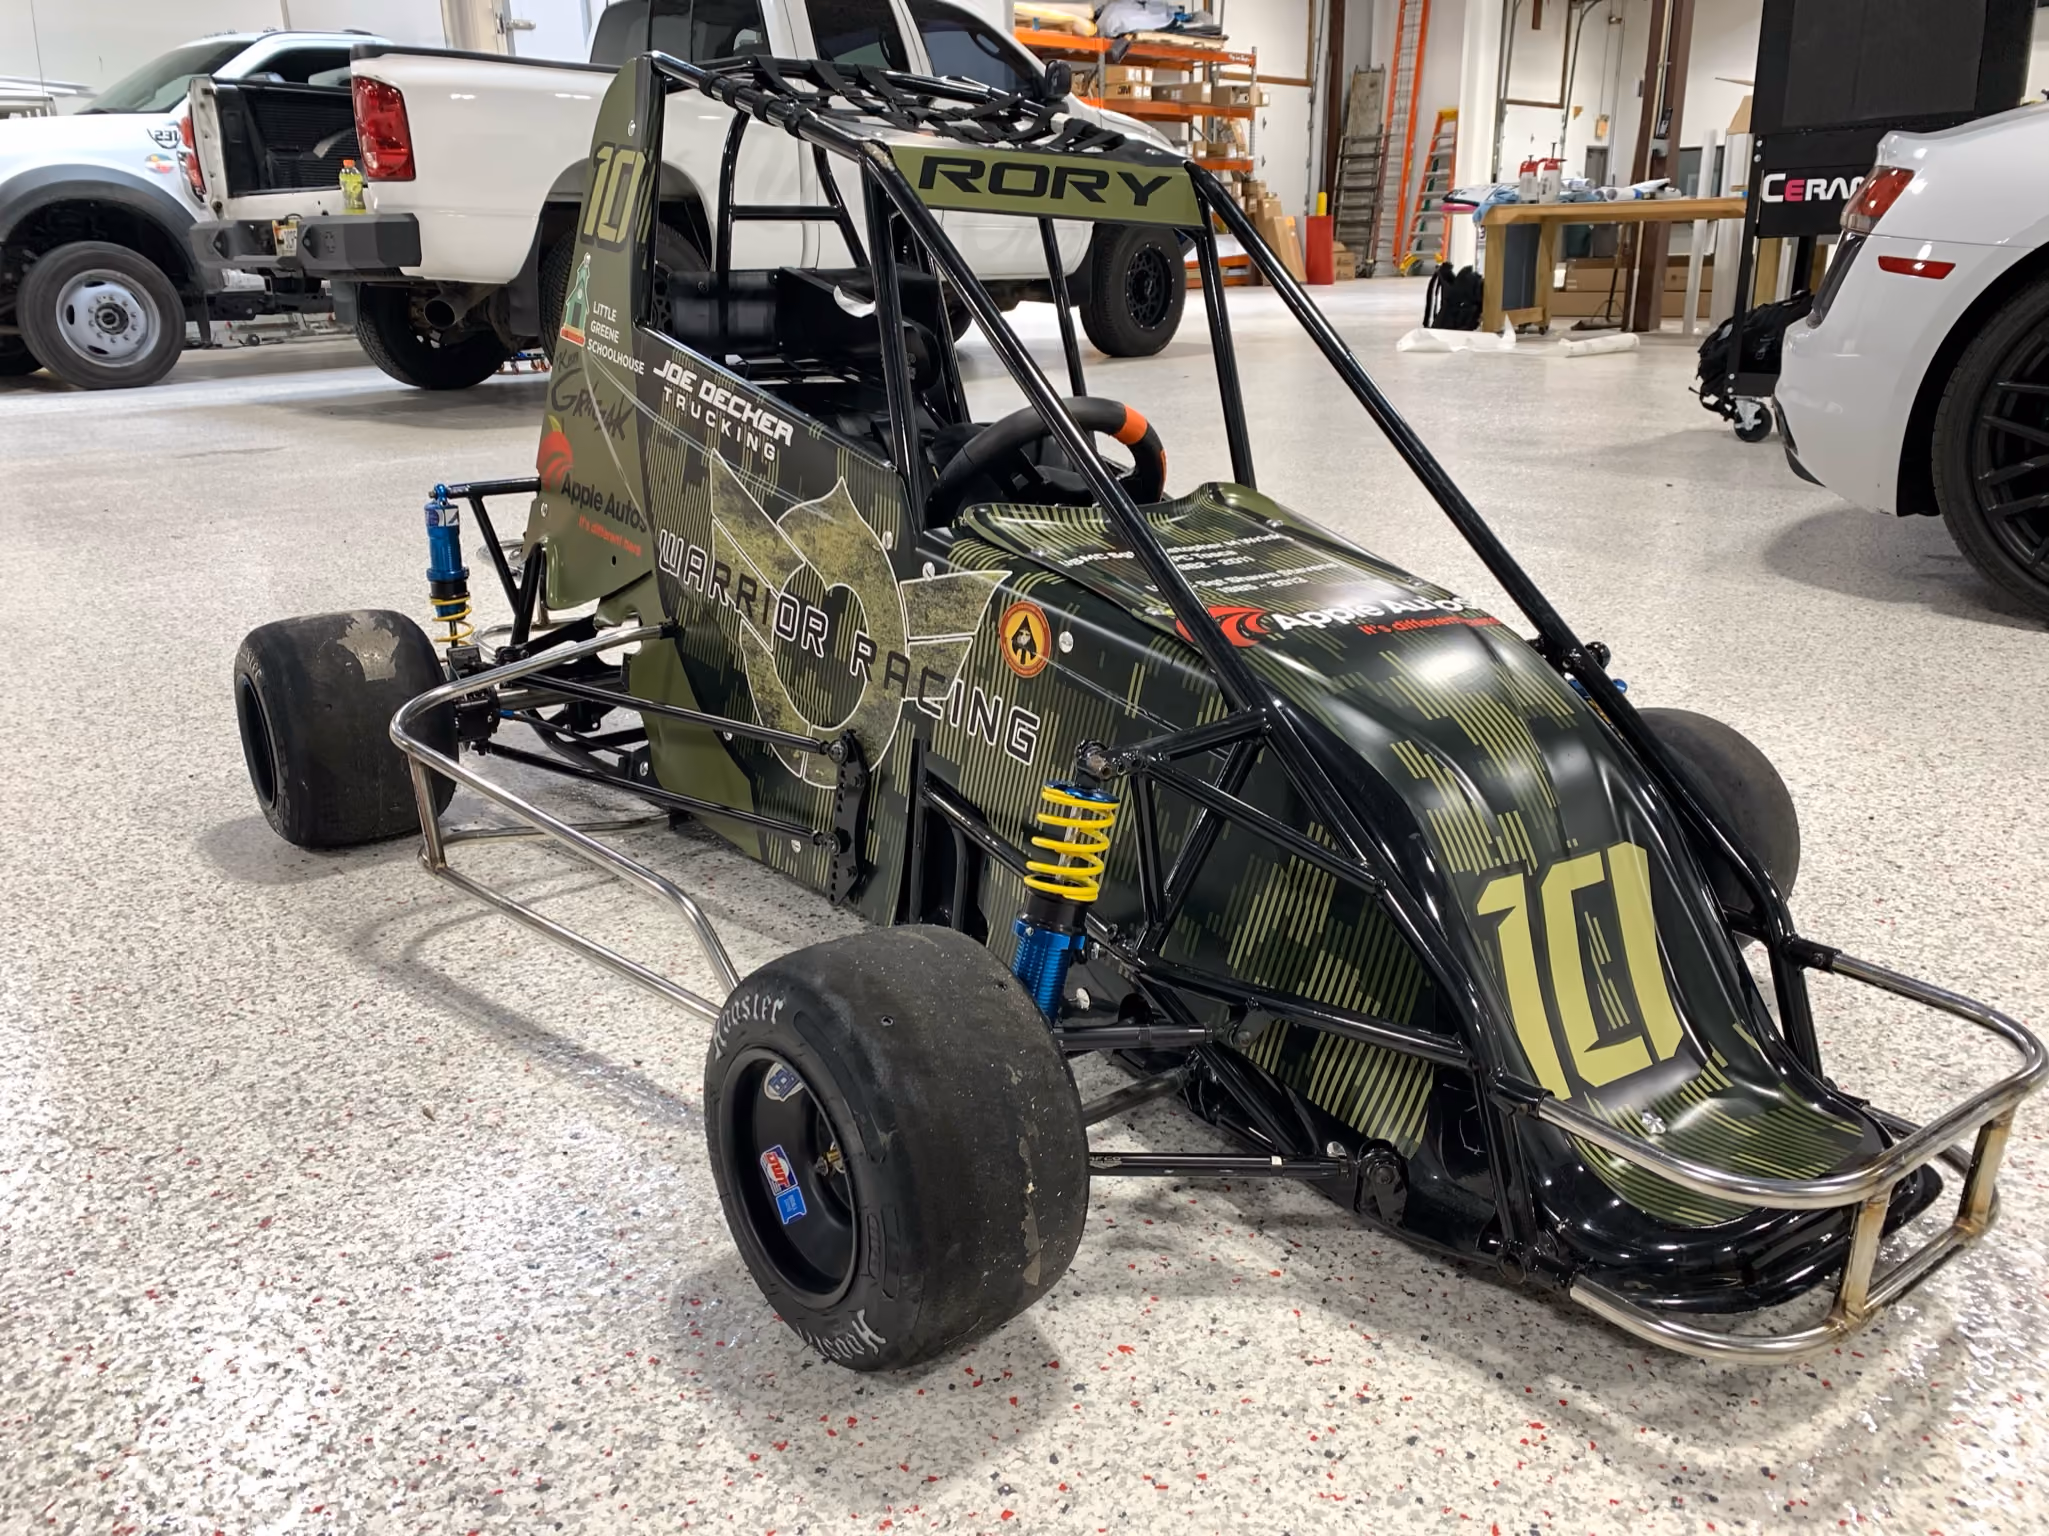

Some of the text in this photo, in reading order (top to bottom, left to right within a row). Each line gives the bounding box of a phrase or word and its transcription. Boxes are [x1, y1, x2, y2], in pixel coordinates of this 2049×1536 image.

[582, 144, 648, 245] 10
[918, 155, 1173, 207] RORY
[589, 320, 620, 344] GREENE
[592, 300, 618, 323] LITTLE
[586, 338, 646, 376] SCHOOLHOUSE
[652, 359, 795, 447] JOE DECKER
[663, 386, 777, 462] TRUCKING
[560, 472, 604, 513] Apple
[1270, 601, 1386, 633] Apple
[658, 528, 830, 659] WARRIOR
[848, 628, 1042, 767] RACING
[1476, 840, 1685, 1102] 10
